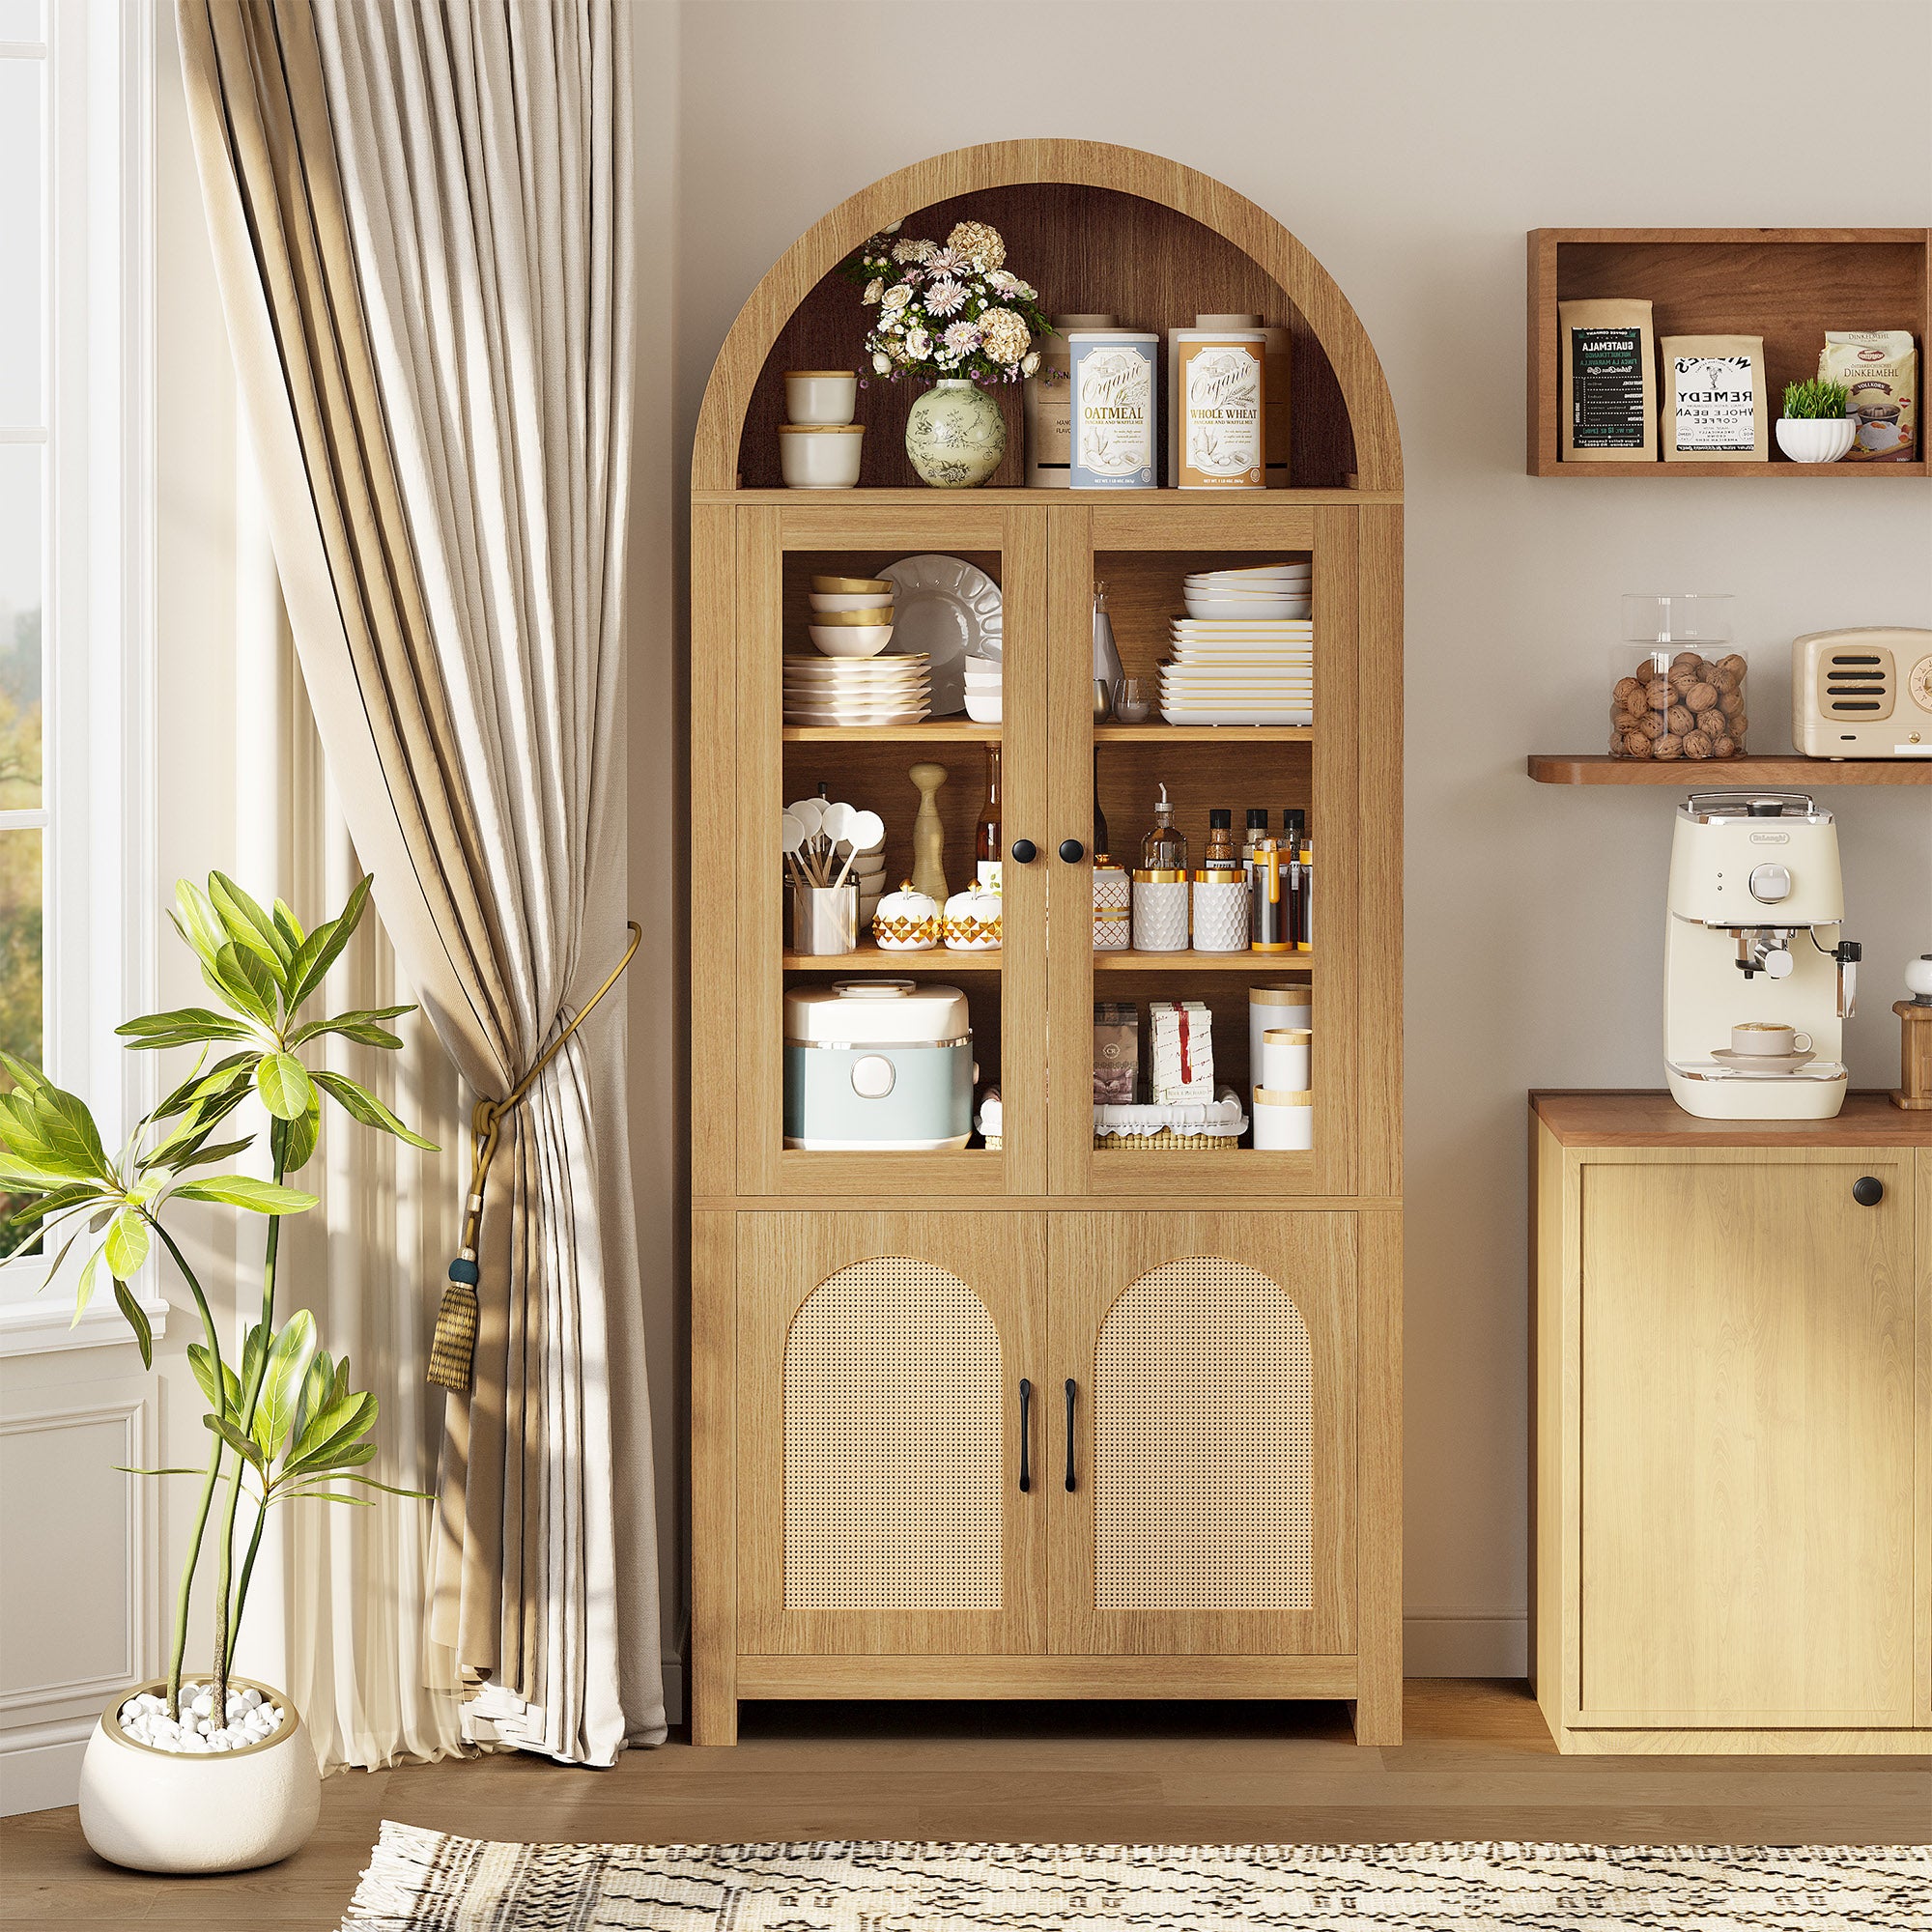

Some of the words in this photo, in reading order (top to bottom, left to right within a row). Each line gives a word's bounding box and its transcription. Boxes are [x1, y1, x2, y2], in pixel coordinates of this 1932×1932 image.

[1844, 368, 1899, 378] DINKELMEHL
[1082, 361, 1143, 405] Organic
[1190, 361, 1253, 405] Organic
[1084, 407, 1144, 420] OATMEAL
[1190, 409, 1224, 419] WHOLE
[1225, 409, 1258, 419] WHEAT
